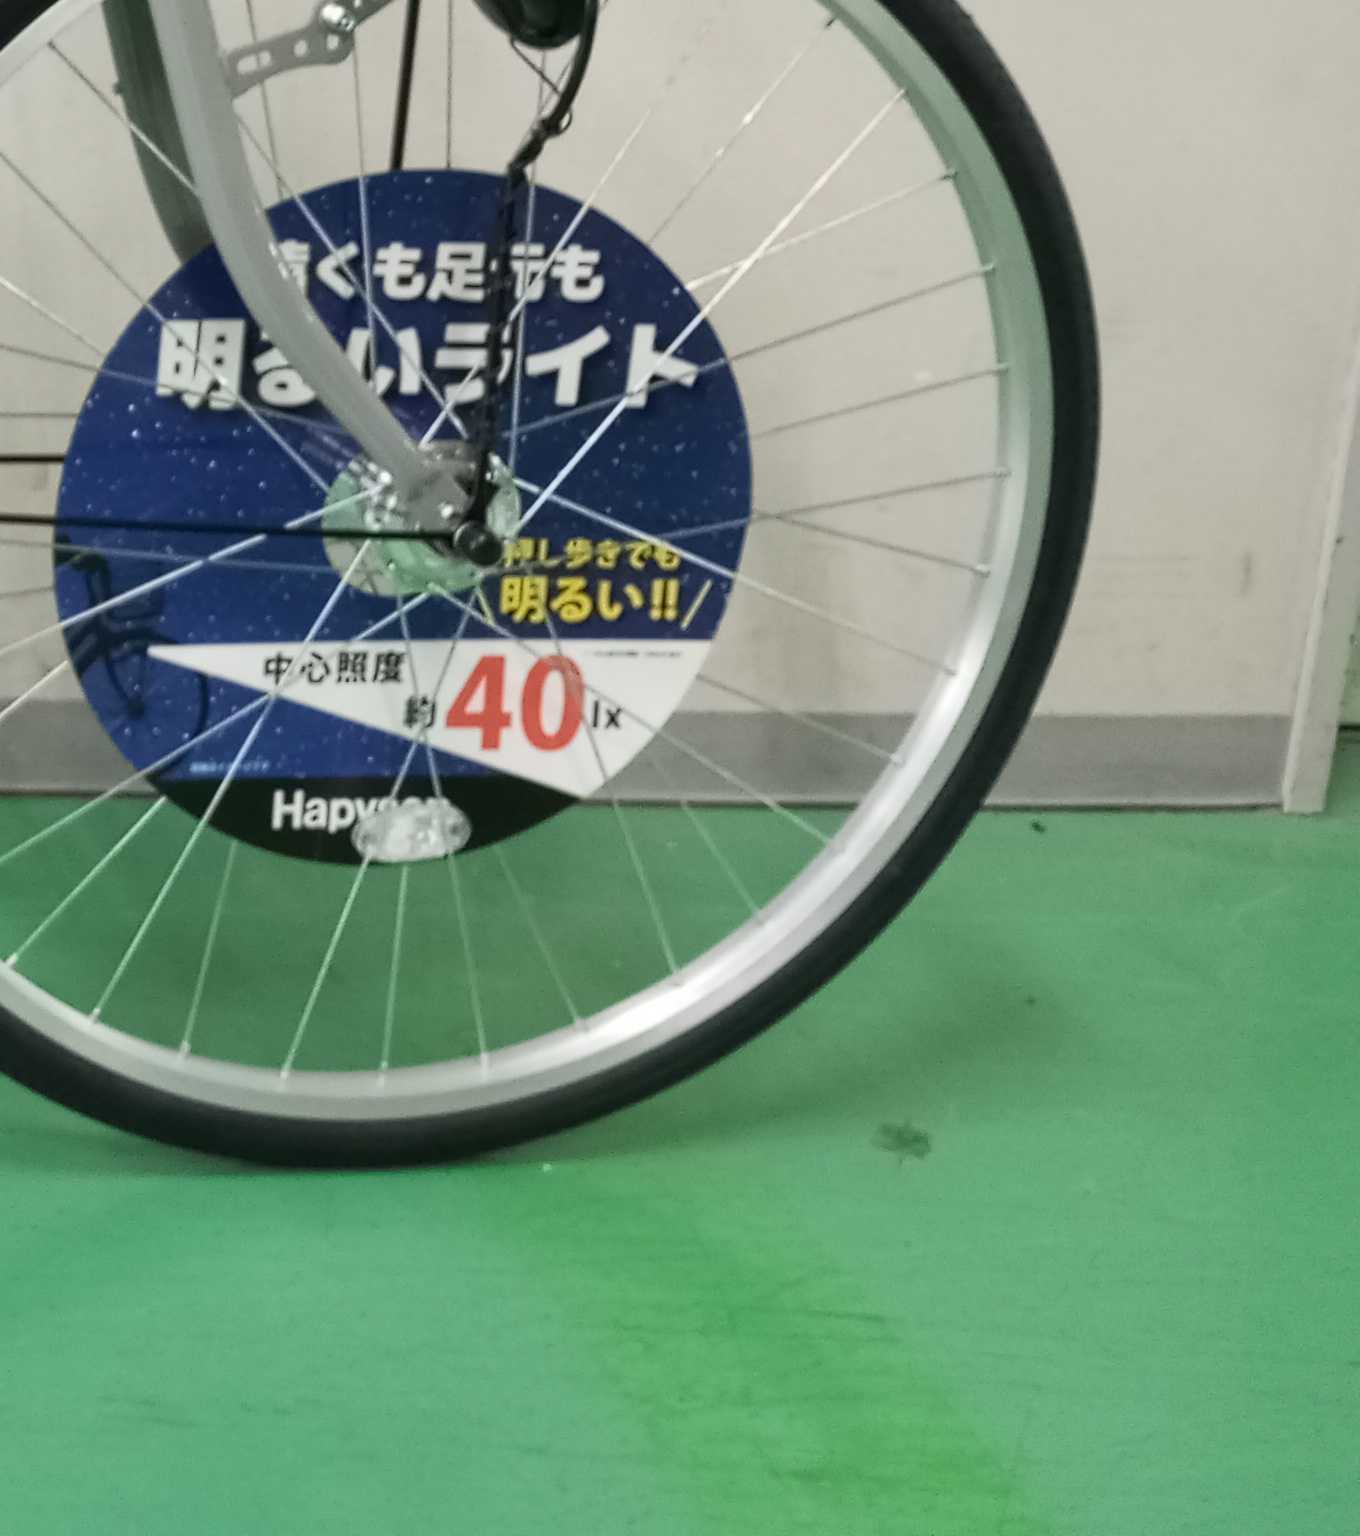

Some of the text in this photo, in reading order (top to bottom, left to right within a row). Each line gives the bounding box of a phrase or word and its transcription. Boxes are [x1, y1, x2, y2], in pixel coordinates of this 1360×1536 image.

[263, 650, 406, 686] 中心照度
[445, 654, 585, 752] 40
[271, 788, 452, 835] Hapy
